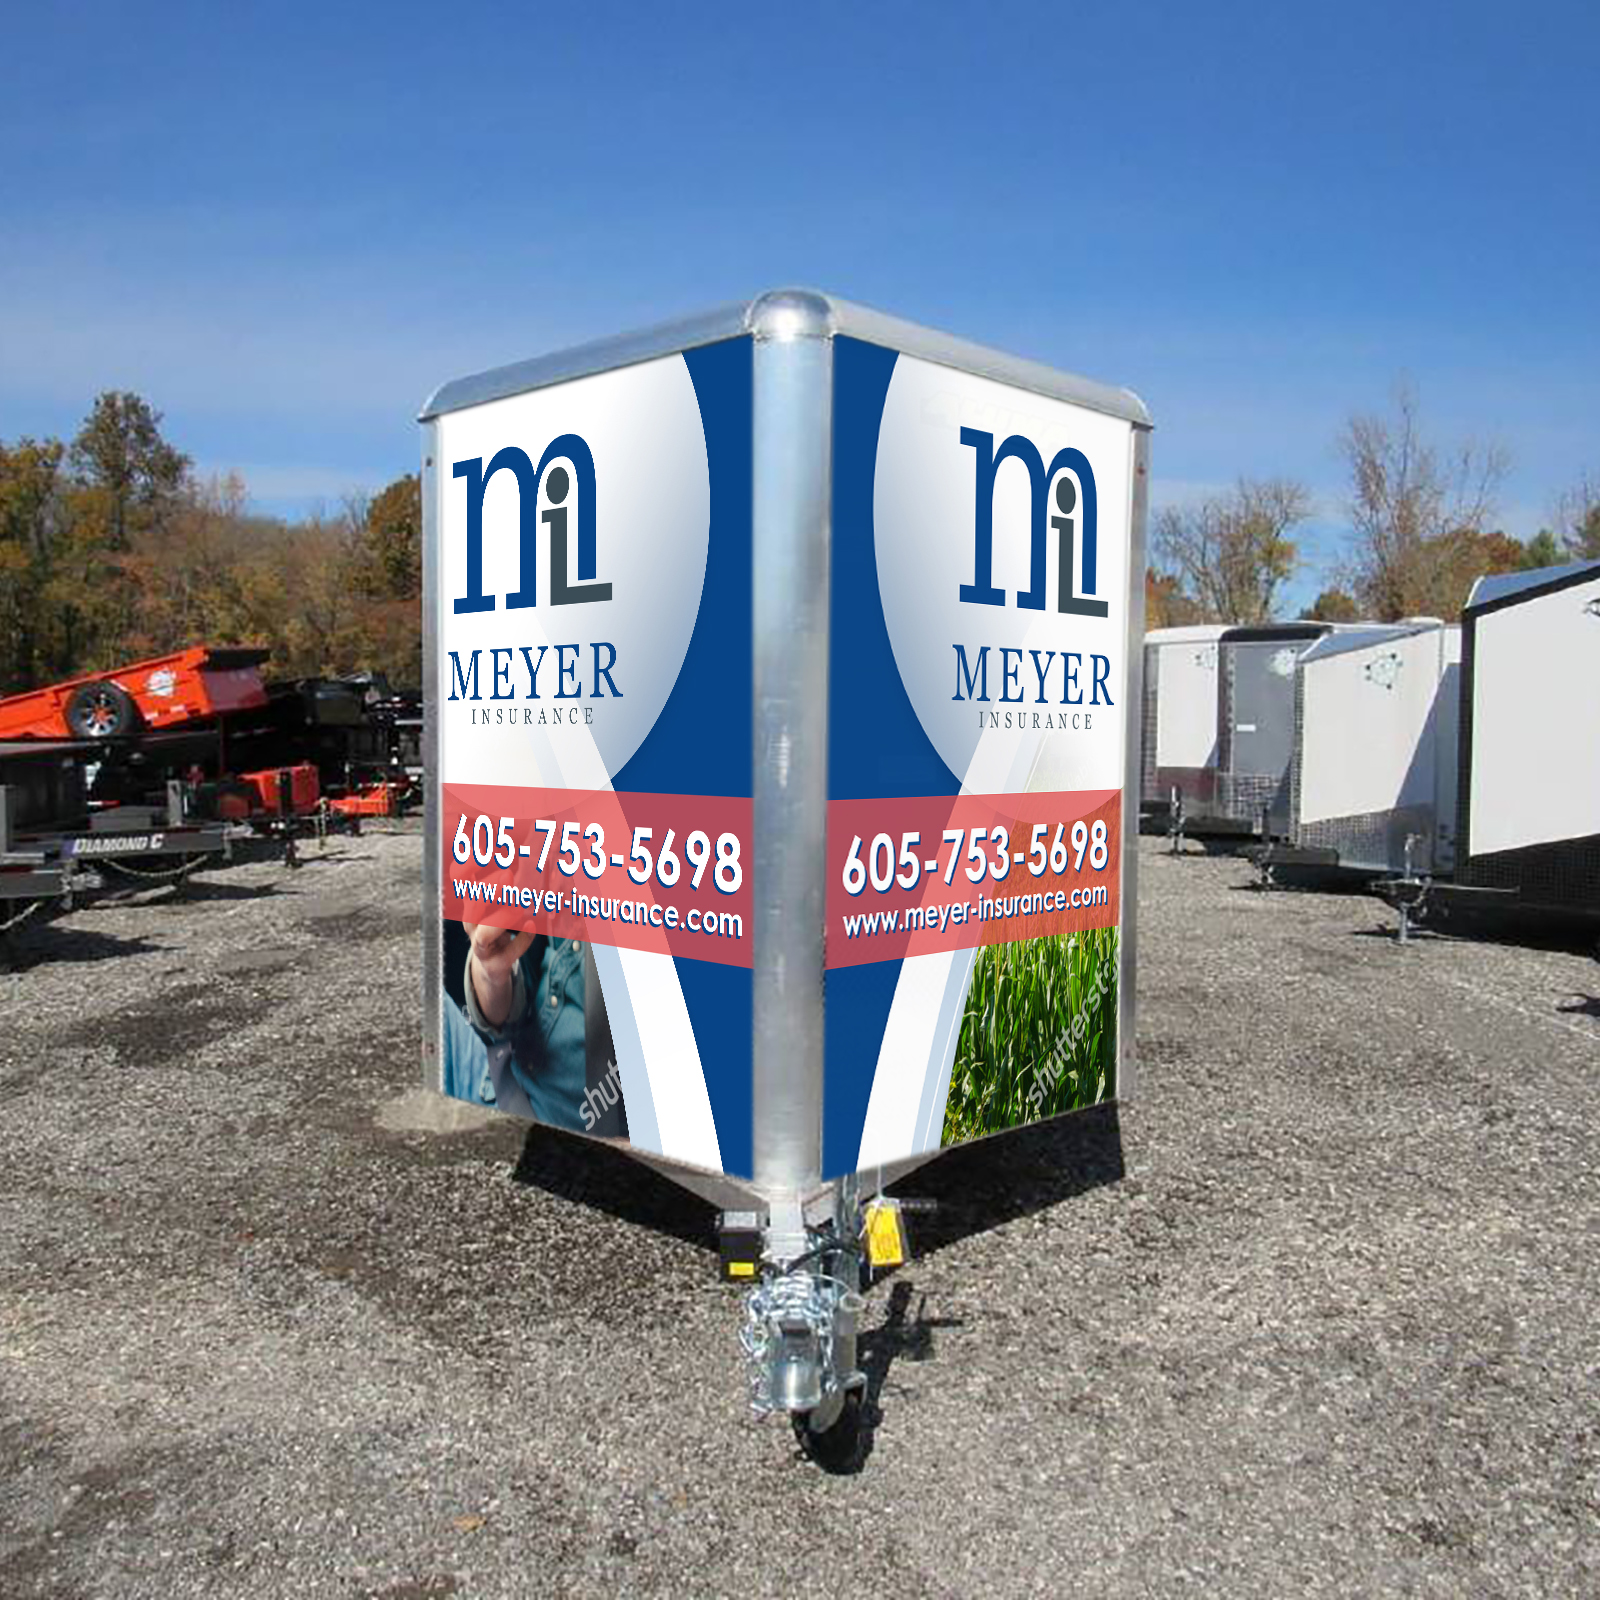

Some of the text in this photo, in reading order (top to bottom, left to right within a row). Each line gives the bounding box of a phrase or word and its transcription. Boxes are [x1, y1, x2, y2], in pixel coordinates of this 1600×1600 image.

[447, 641, 624, 701] MEYER
[951, 643, 1115, 706] MEYER
[471, 706, 594, 725] INSURANCE
[978, 710, 1093, 730] INSURANCE
[72, 833, 164, 855] DIAMOND C
[451, 813, 743, 897] 605-753-5698
[842, 819, 1110, 897] 605-753-5698
[453, 878, 743, 940] www.meyer-insurance.com
[841, 884, 1108, 937] www.meyer-insurance.com
